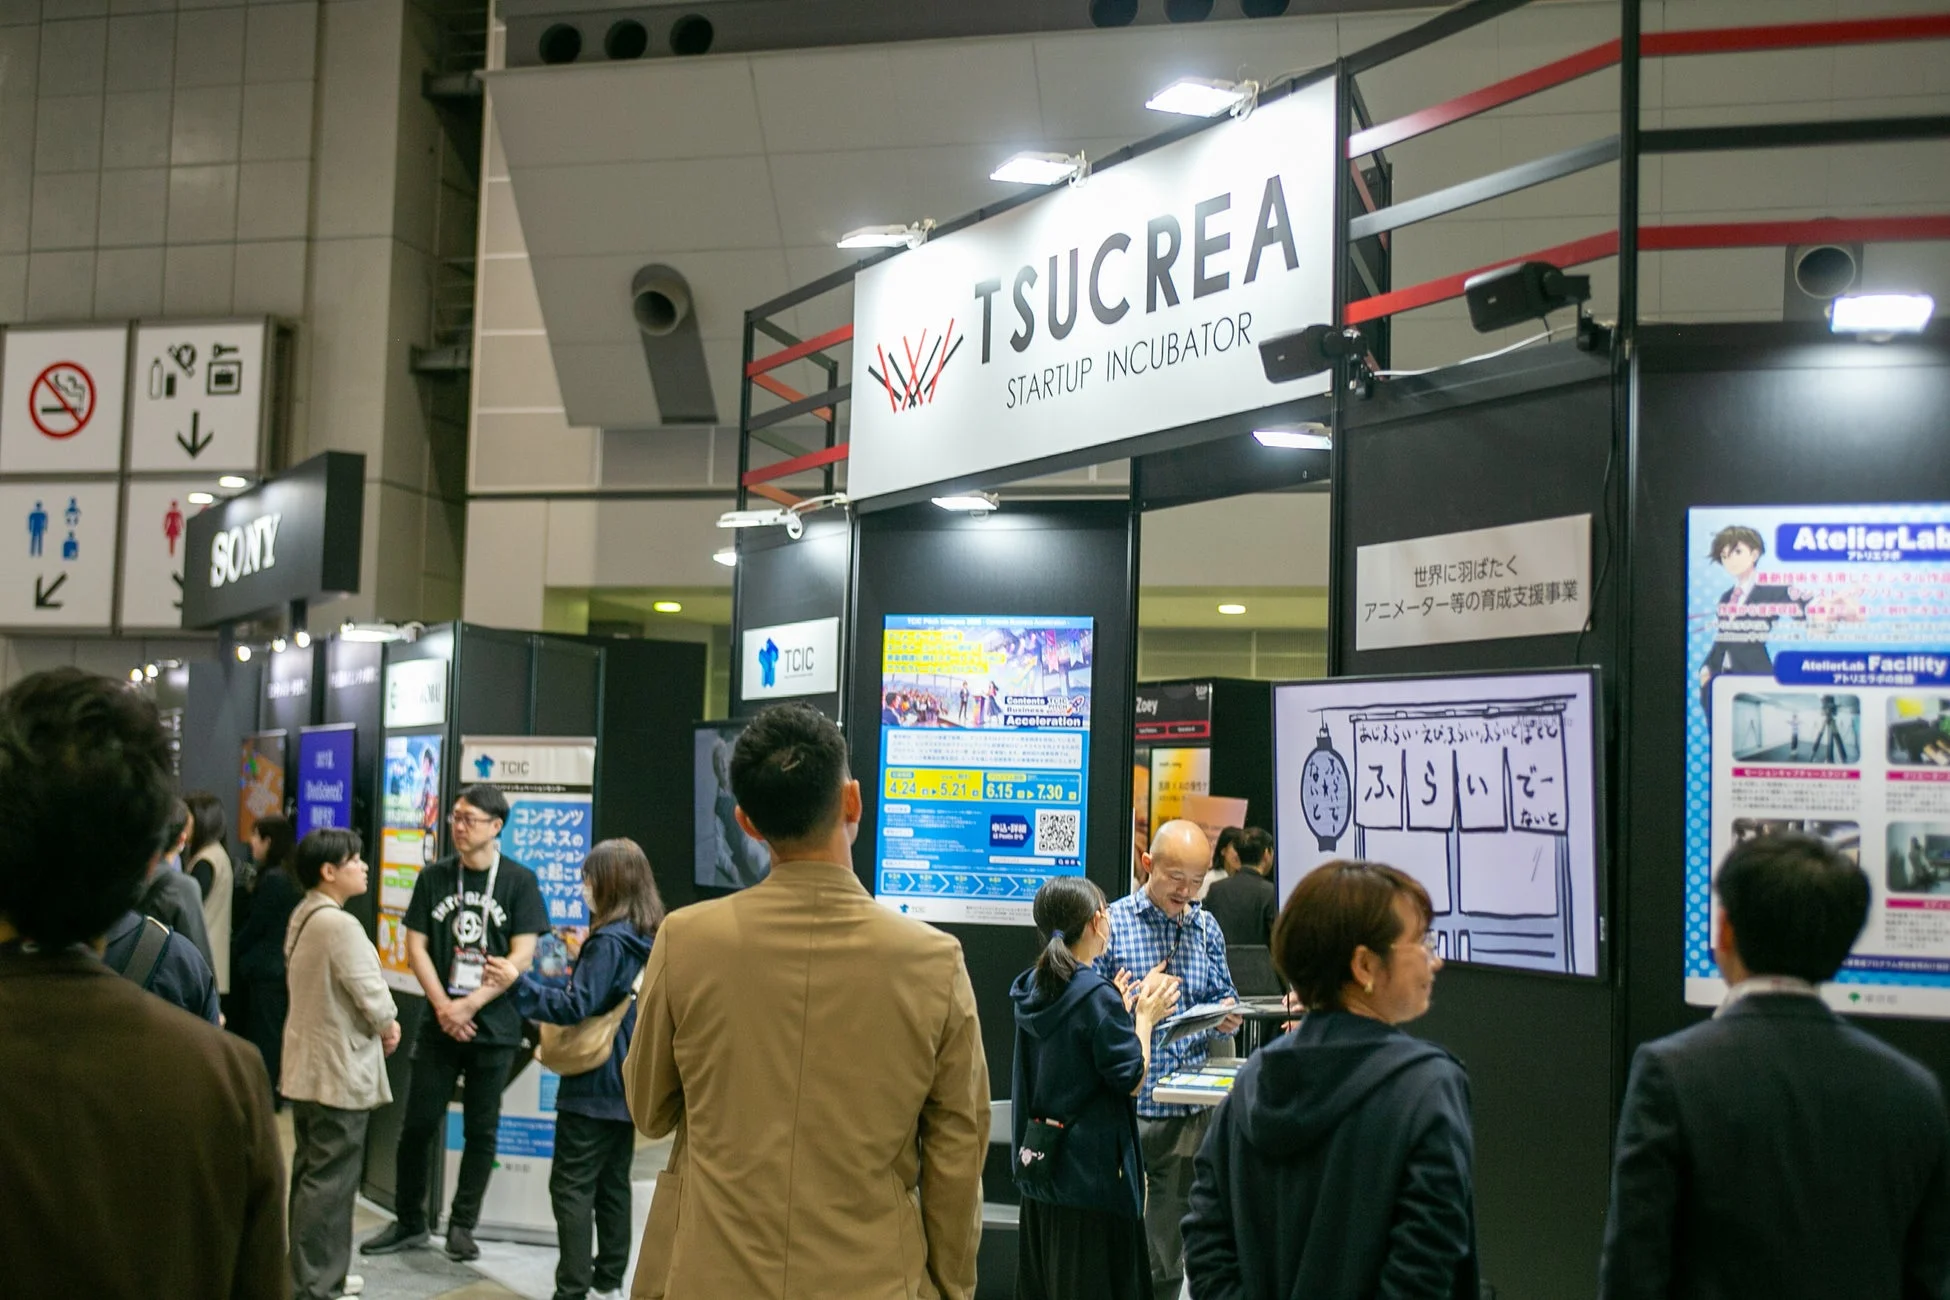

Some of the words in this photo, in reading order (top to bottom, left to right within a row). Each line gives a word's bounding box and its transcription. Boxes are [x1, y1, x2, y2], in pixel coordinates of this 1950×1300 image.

[974, 173, 1300, 365] TSUCREA
[1006, 357, 1093, 410] STARTUP
[1106, 311, 1253, 382] INCUBATOR
[210, 513, 283, 588] SONY
[1414, 555, 1519, 589] 世界に羽ばたく
[1364, 580, 1579, 623] アニメーター等の育成支援事業
[784, 647, 815, 673] TCIC
[1868, 656, 1946, 679] Facility
[1006, 697, 1046, 705] Contents
[1136, 697, 1158, 716] Zoey
[1006, 716, 1081, 727] Acceleration
[500, 761, 530, 774] TCIC
[890, 781, 916, 795] 4.24
[940, 782, 967, 797] 5.21
[986, 783, 1013, 799] 6.15
[1037, 784, 1063, 800] 7.30
[1309, 759, 1321, 821] ないと
[513, 808, 585, 827] コンテンツ
[1520, 807, 1559, 828] ないと
[512, 829, 584, 847] ビジネスの
[513, 848, 585, 862] イノベーション
